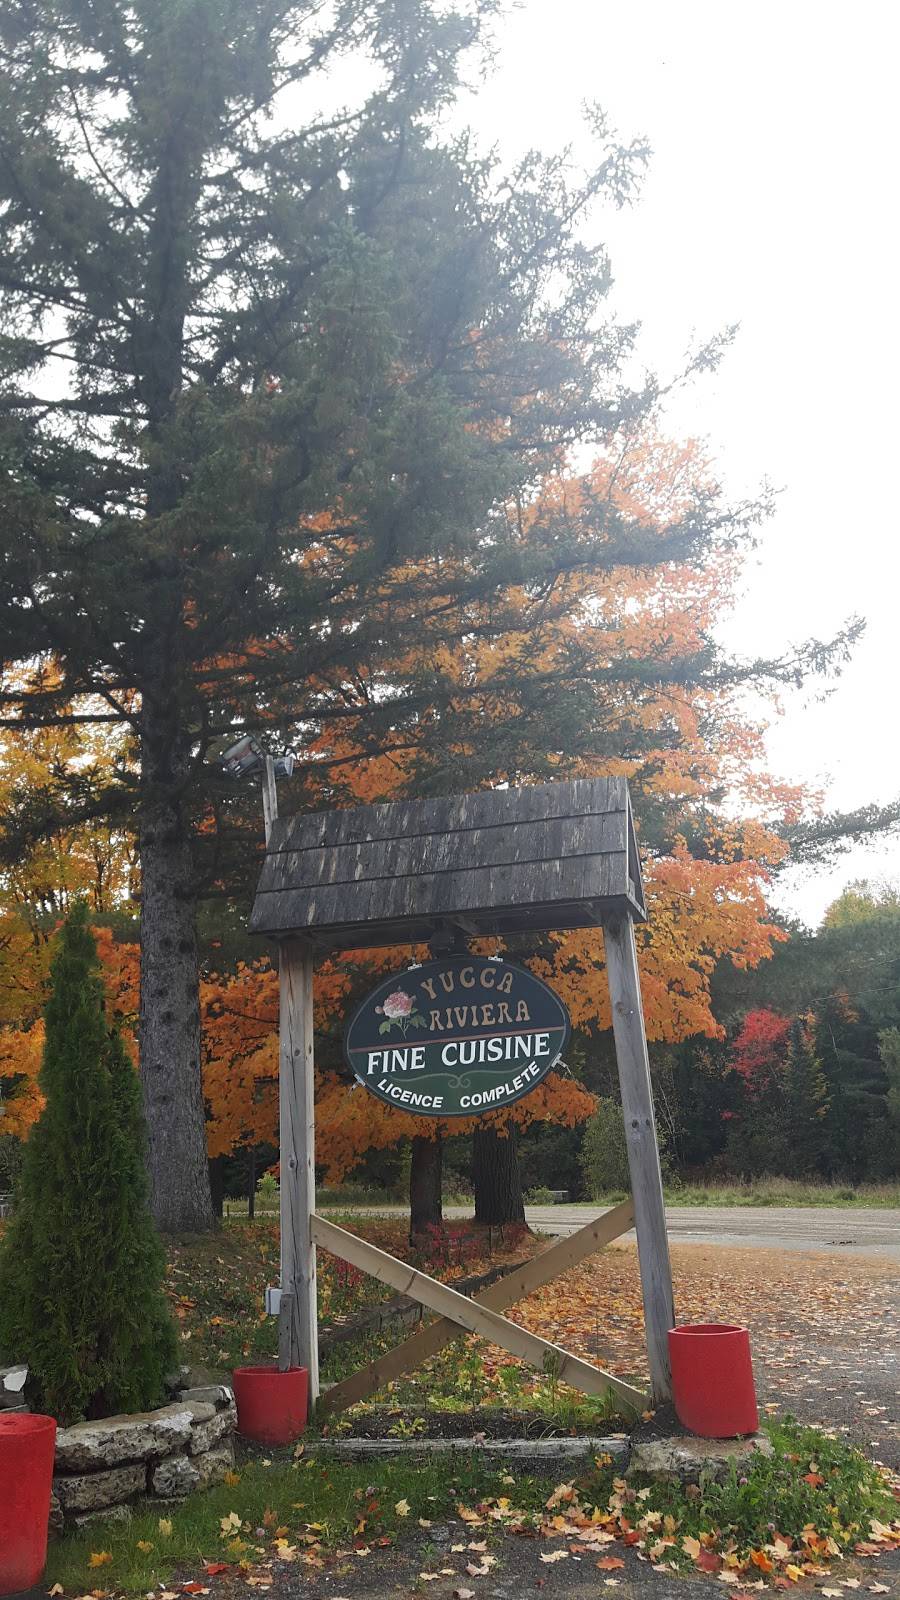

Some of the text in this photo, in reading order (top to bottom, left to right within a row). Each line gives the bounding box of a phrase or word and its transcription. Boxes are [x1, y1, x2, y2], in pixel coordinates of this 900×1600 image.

[420, 966, 513, 999] YUCCA
[429, 1000, 530, 1031] RIVIERA
[366, 1033, 550, 1075] FINE CUISINE
[377, 1061, 540, 1108] LICENCE COMPLETE
